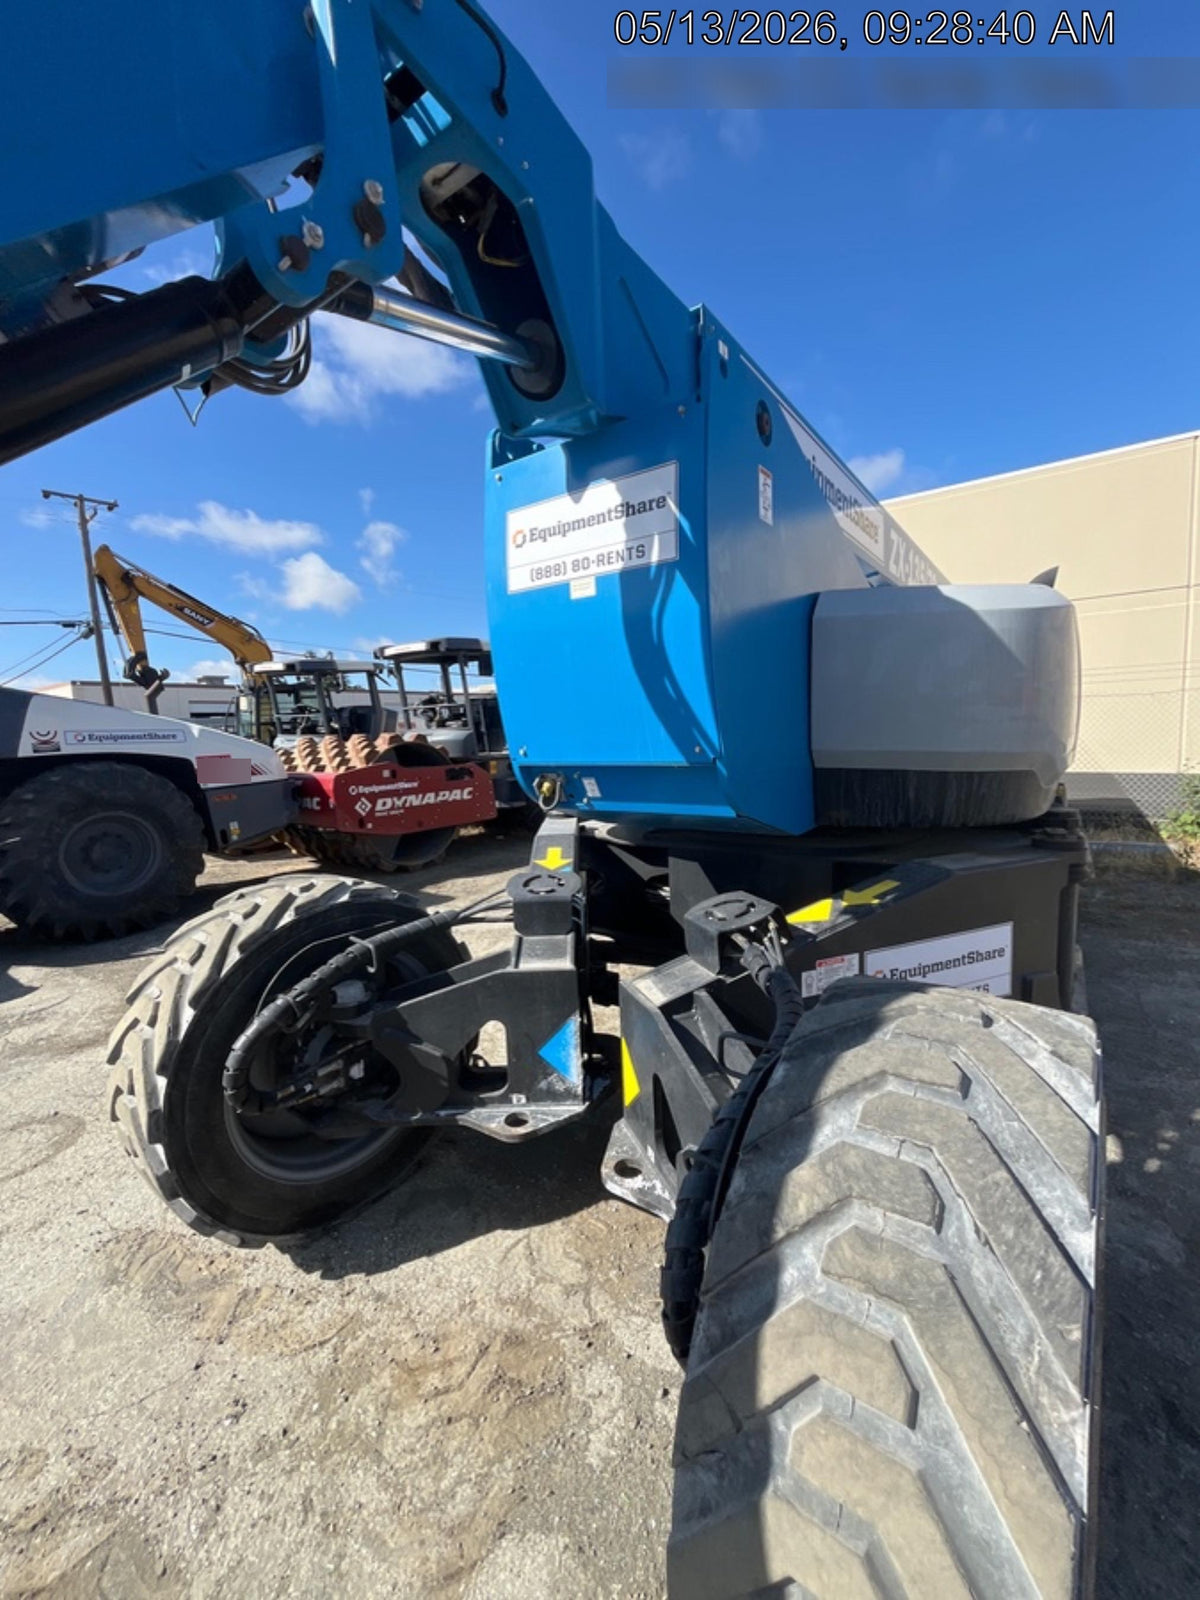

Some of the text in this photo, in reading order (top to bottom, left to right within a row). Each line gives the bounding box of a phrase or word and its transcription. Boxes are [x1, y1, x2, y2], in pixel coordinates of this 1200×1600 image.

[529, 494, 667, 543] EquipmentShare
[530, 563, 567, 582] (888)
[88, 732, 177, 743] EquipmentShare
[358, 781, 419, 794] EquipmentShare
[375, 787, 474, 812] DYNAPAC
[889, 945, 1005, 980] EquipmentShare
